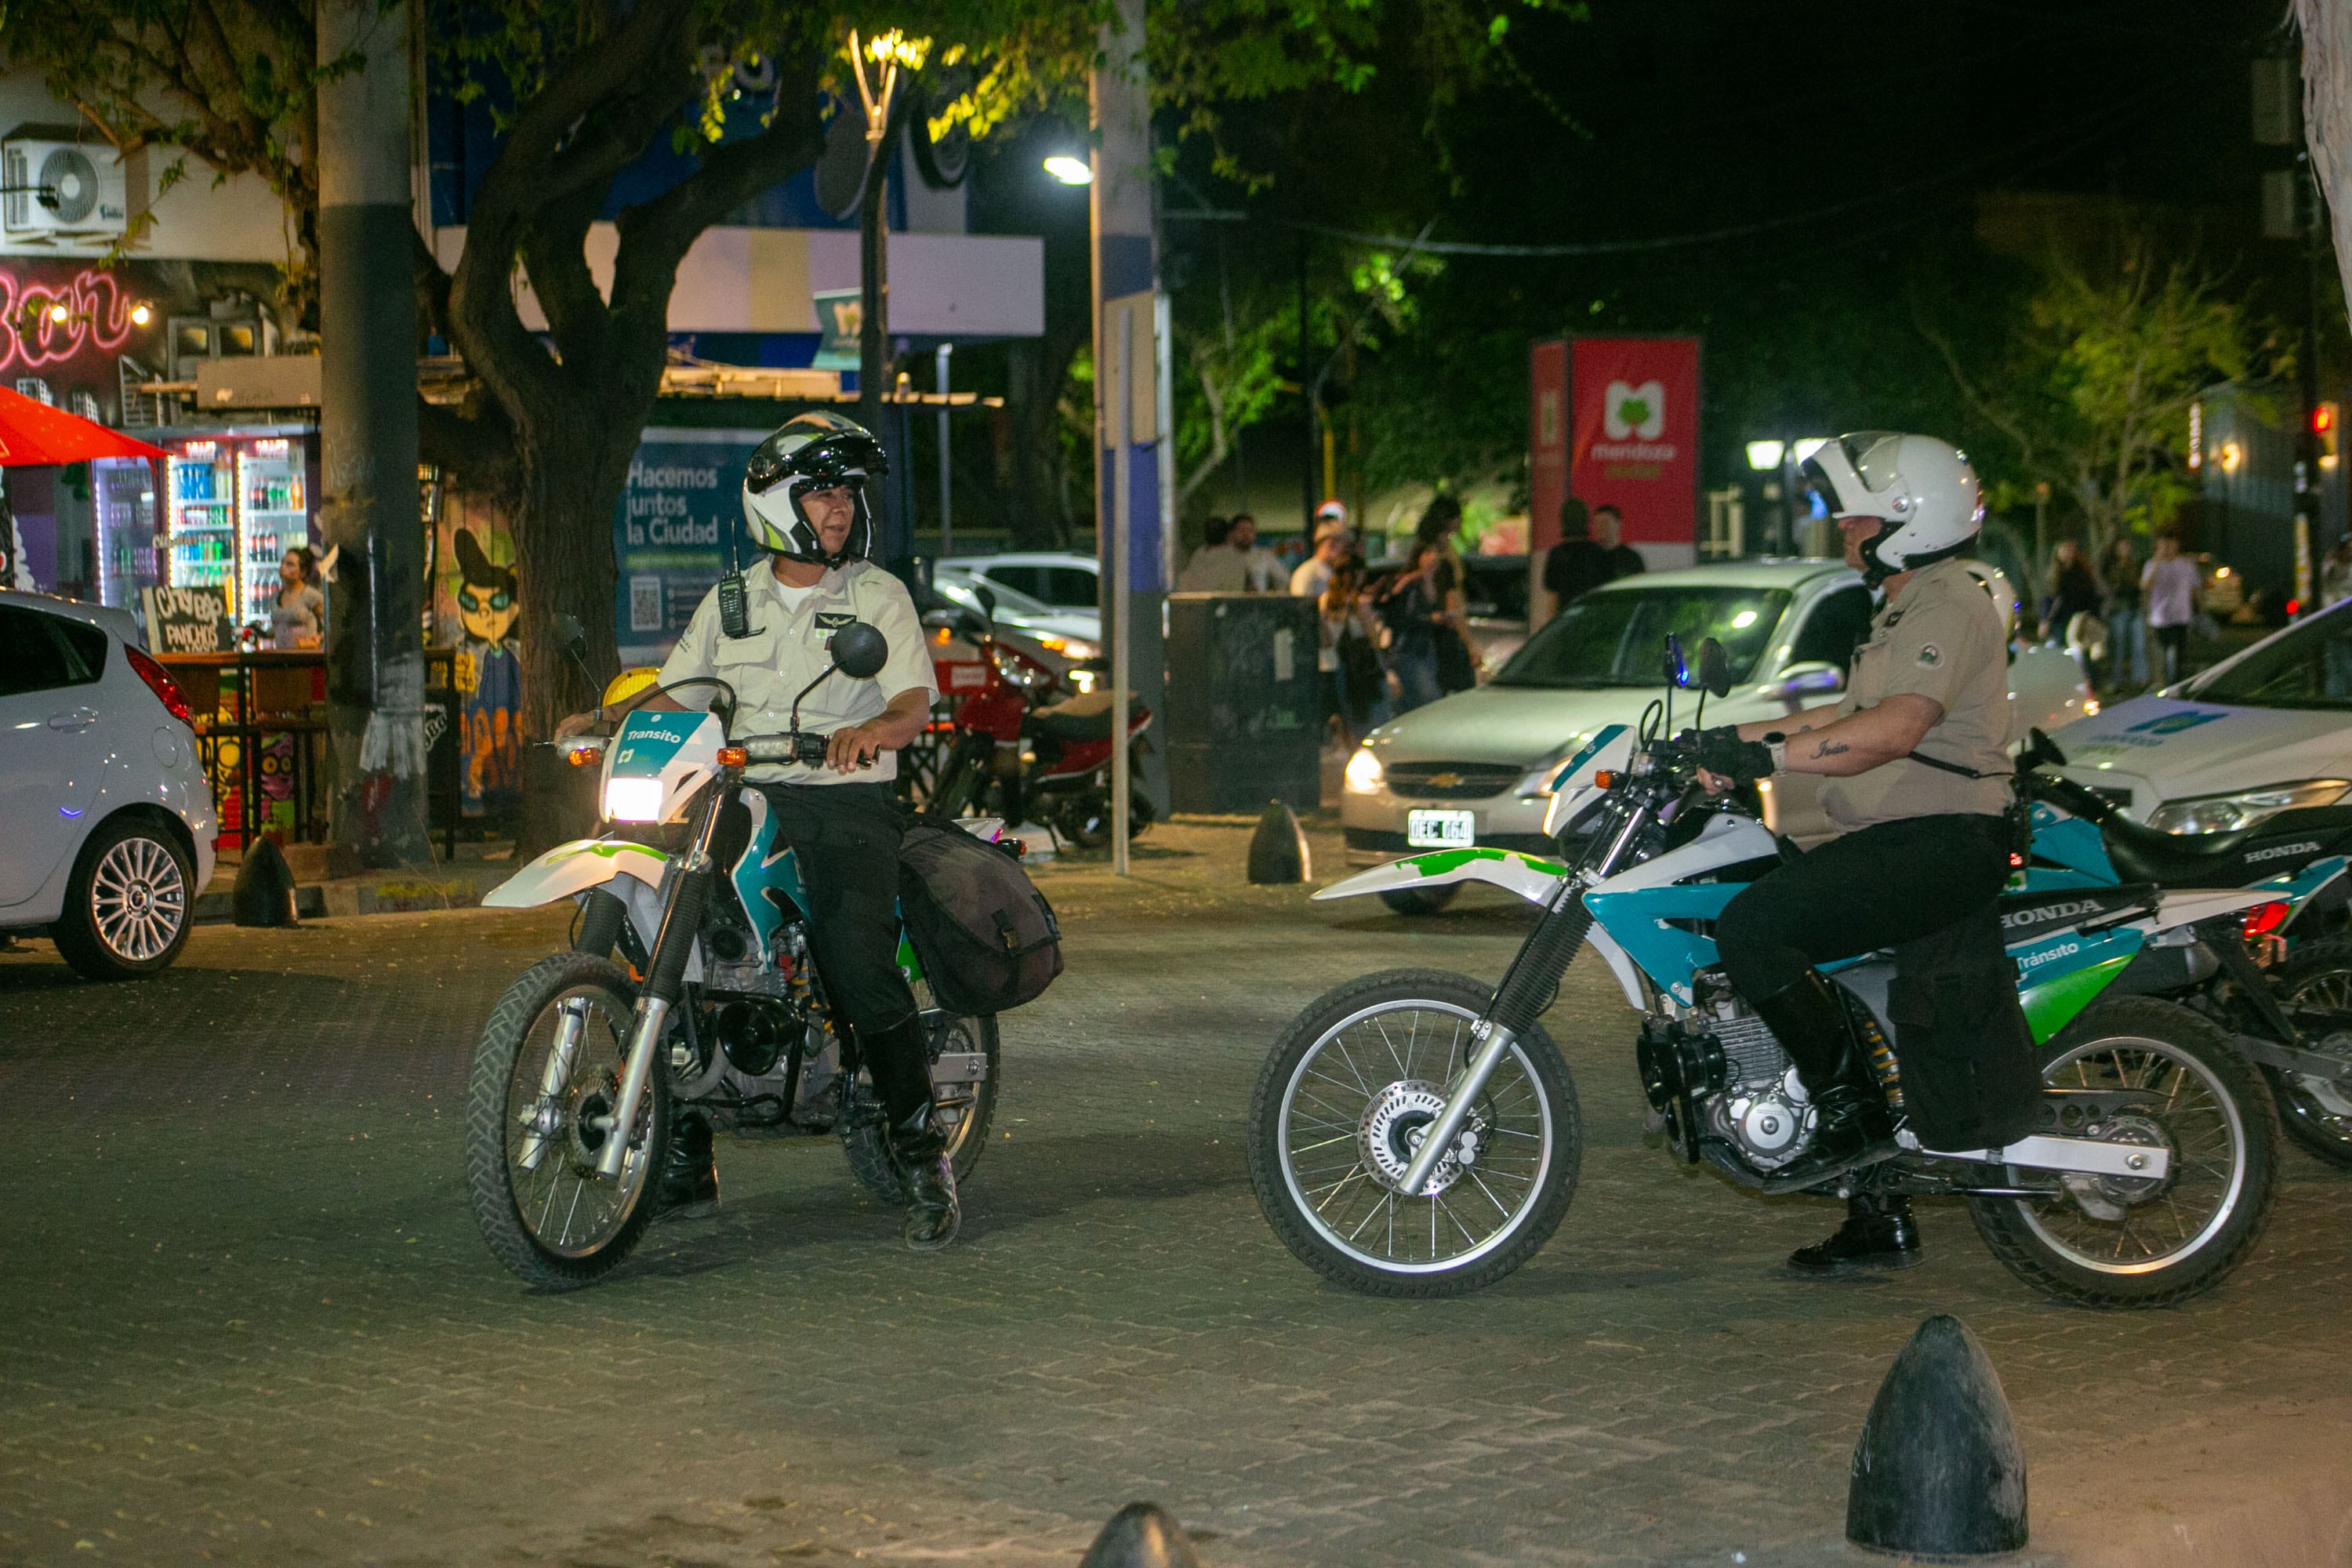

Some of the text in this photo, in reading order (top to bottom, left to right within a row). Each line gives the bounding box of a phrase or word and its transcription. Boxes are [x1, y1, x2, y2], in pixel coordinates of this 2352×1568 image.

[628, 460, 717, 489] Hacemos
[626, 487, 687, 520] juntos
[627, 514, 718, 545] la Ciudad
[165, 624, 218, 648] PANCHOS
[2244, 841, 2321, 863] HONDA
[2016, 943, 2079, 970] Tránsito
